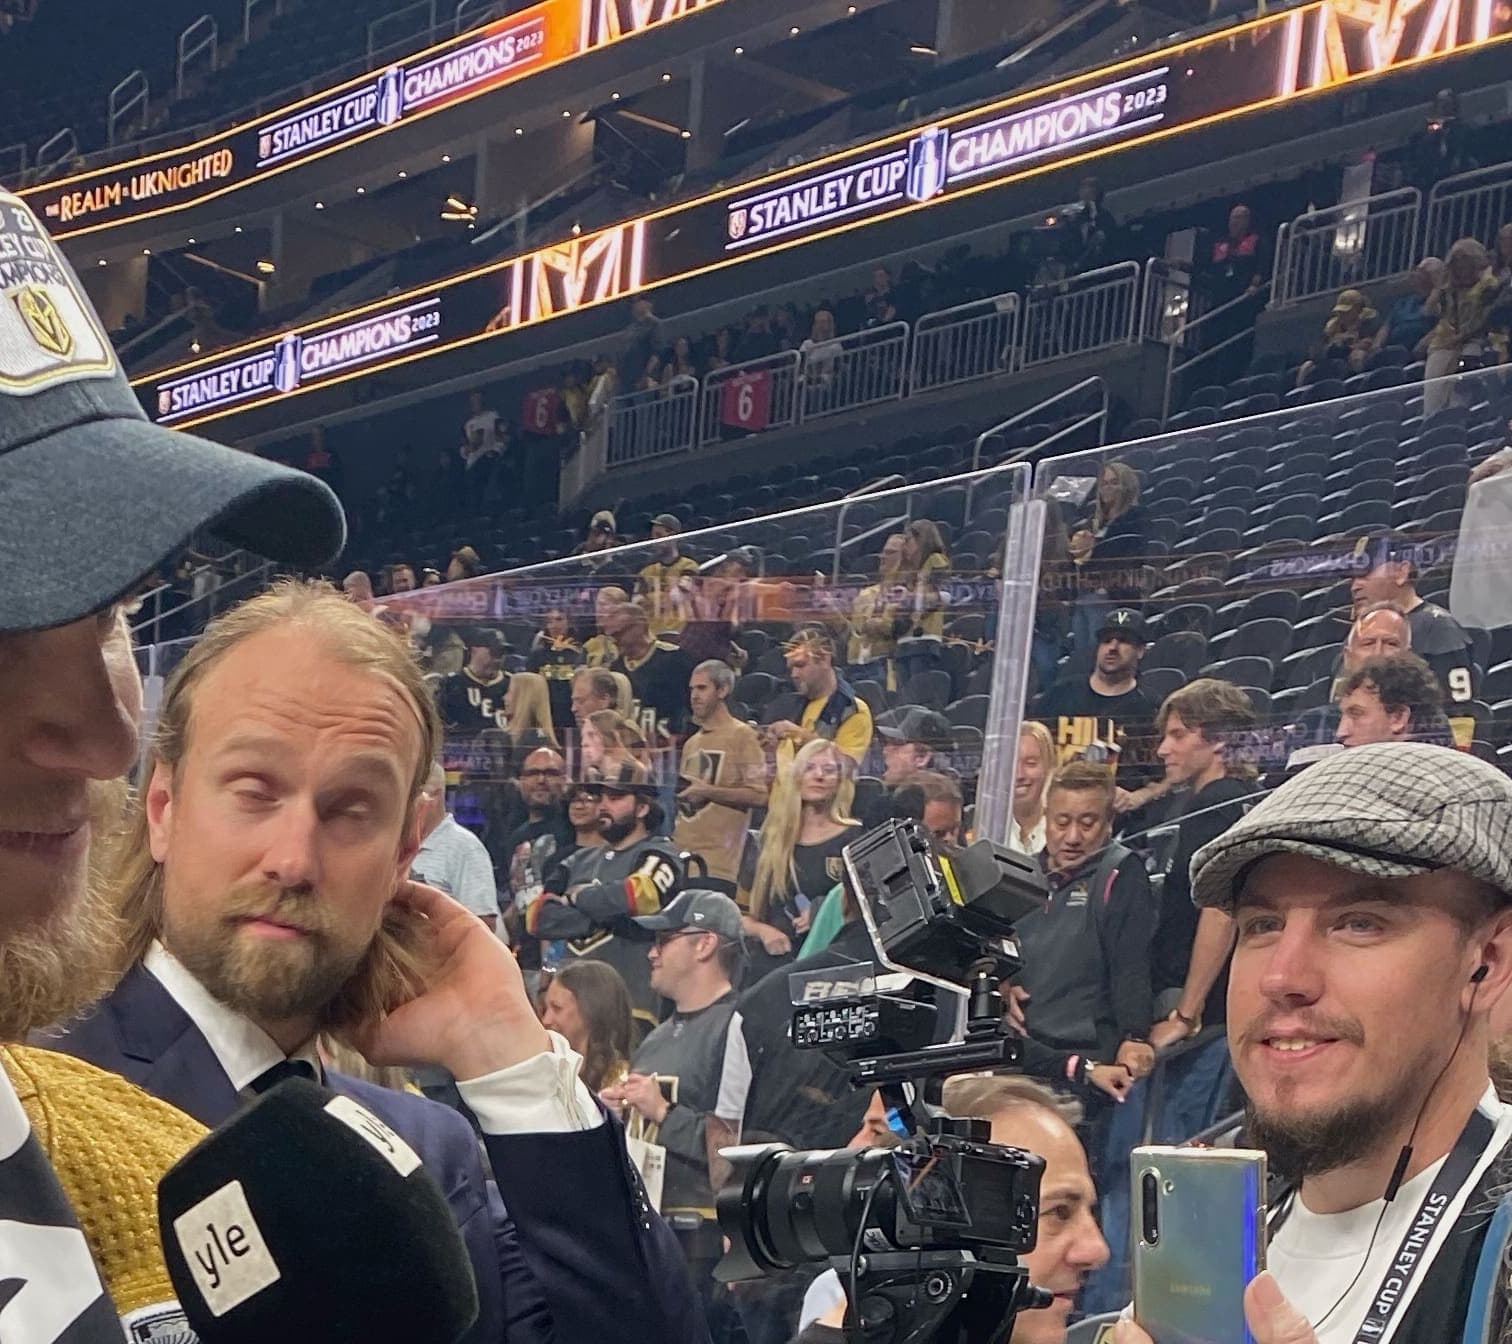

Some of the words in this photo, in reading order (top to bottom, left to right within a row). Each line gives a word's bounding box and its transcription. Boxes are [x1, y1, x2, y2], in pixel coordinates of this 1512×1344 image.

[271, 106, 343, 153] STANLEY
[344, 93, 377, 126] CUP
[403, 36, 516, 101] CHAMPIONS
[516, 30, 544, 53] 2023
[60, 181, 121, 222] REALM
[131, 149, 233, 200] UKNIGHTED
[748, 175, 856, 234] STANLEY
[857, 159, 906, 201] CUP
[947, 90, 1120, 173] CHAMPIONS
[1123, 84, 1168, 114] 2023
[170, 368, 241, 410] STANLEY
[242, 359, 275, 390] CUP
[301, 314, 412, 370] CHAMPIONS
[412, 312, 441, 333] 2023
[738, 384, 753, 421] 6
[639, 855, 676, 895] 12
[195, 1222, 251, 1289] yle
[1394, 1192, 1448, 1276] STANLEY
[1375, 1277, 1403, 1315] CUP
